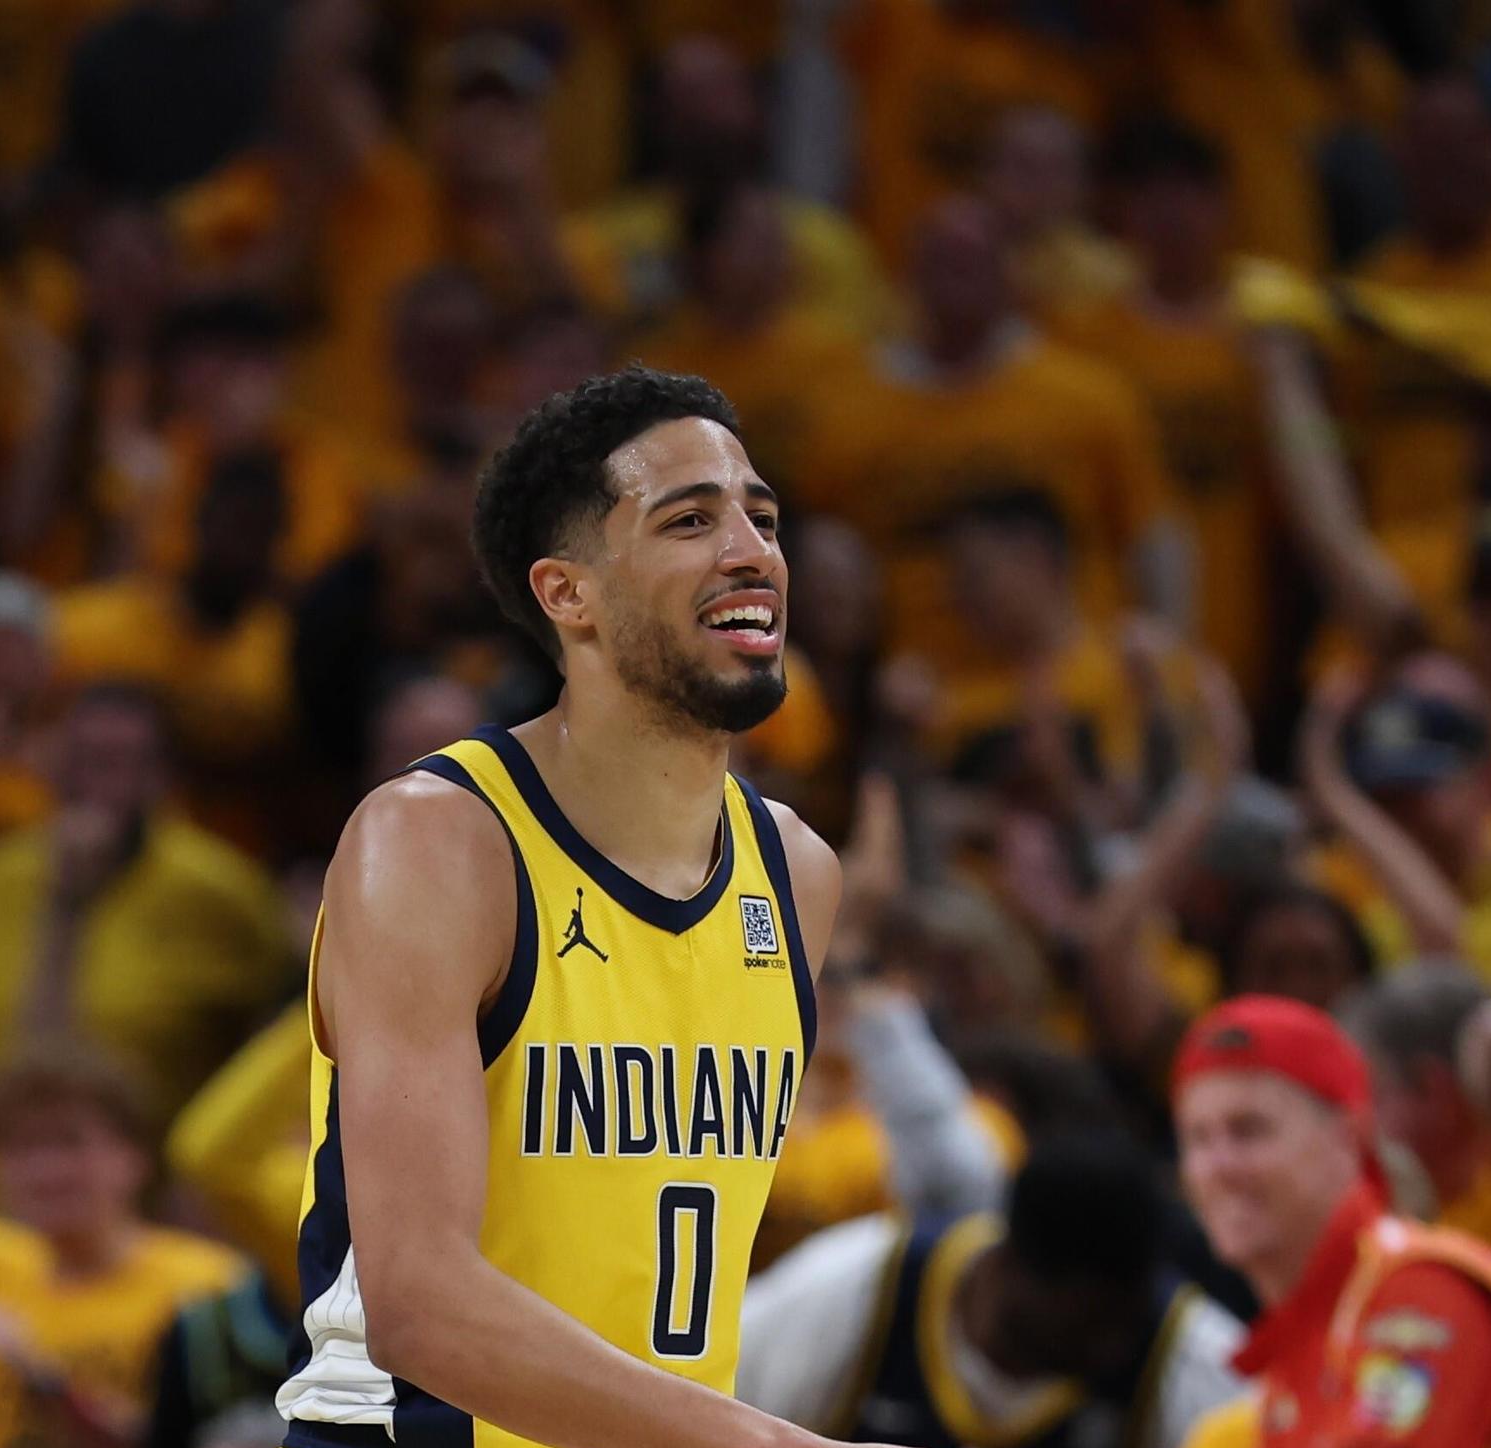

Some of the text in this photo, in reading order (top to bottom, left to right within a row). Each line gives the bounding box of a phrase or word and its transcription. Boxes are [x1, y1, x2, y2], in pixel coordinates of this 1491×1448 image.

[743, 955, 786, 971] spokenote
[521, 1042, 795, 1161] INDIANA
[650, 1181, 718, 1361] 0
